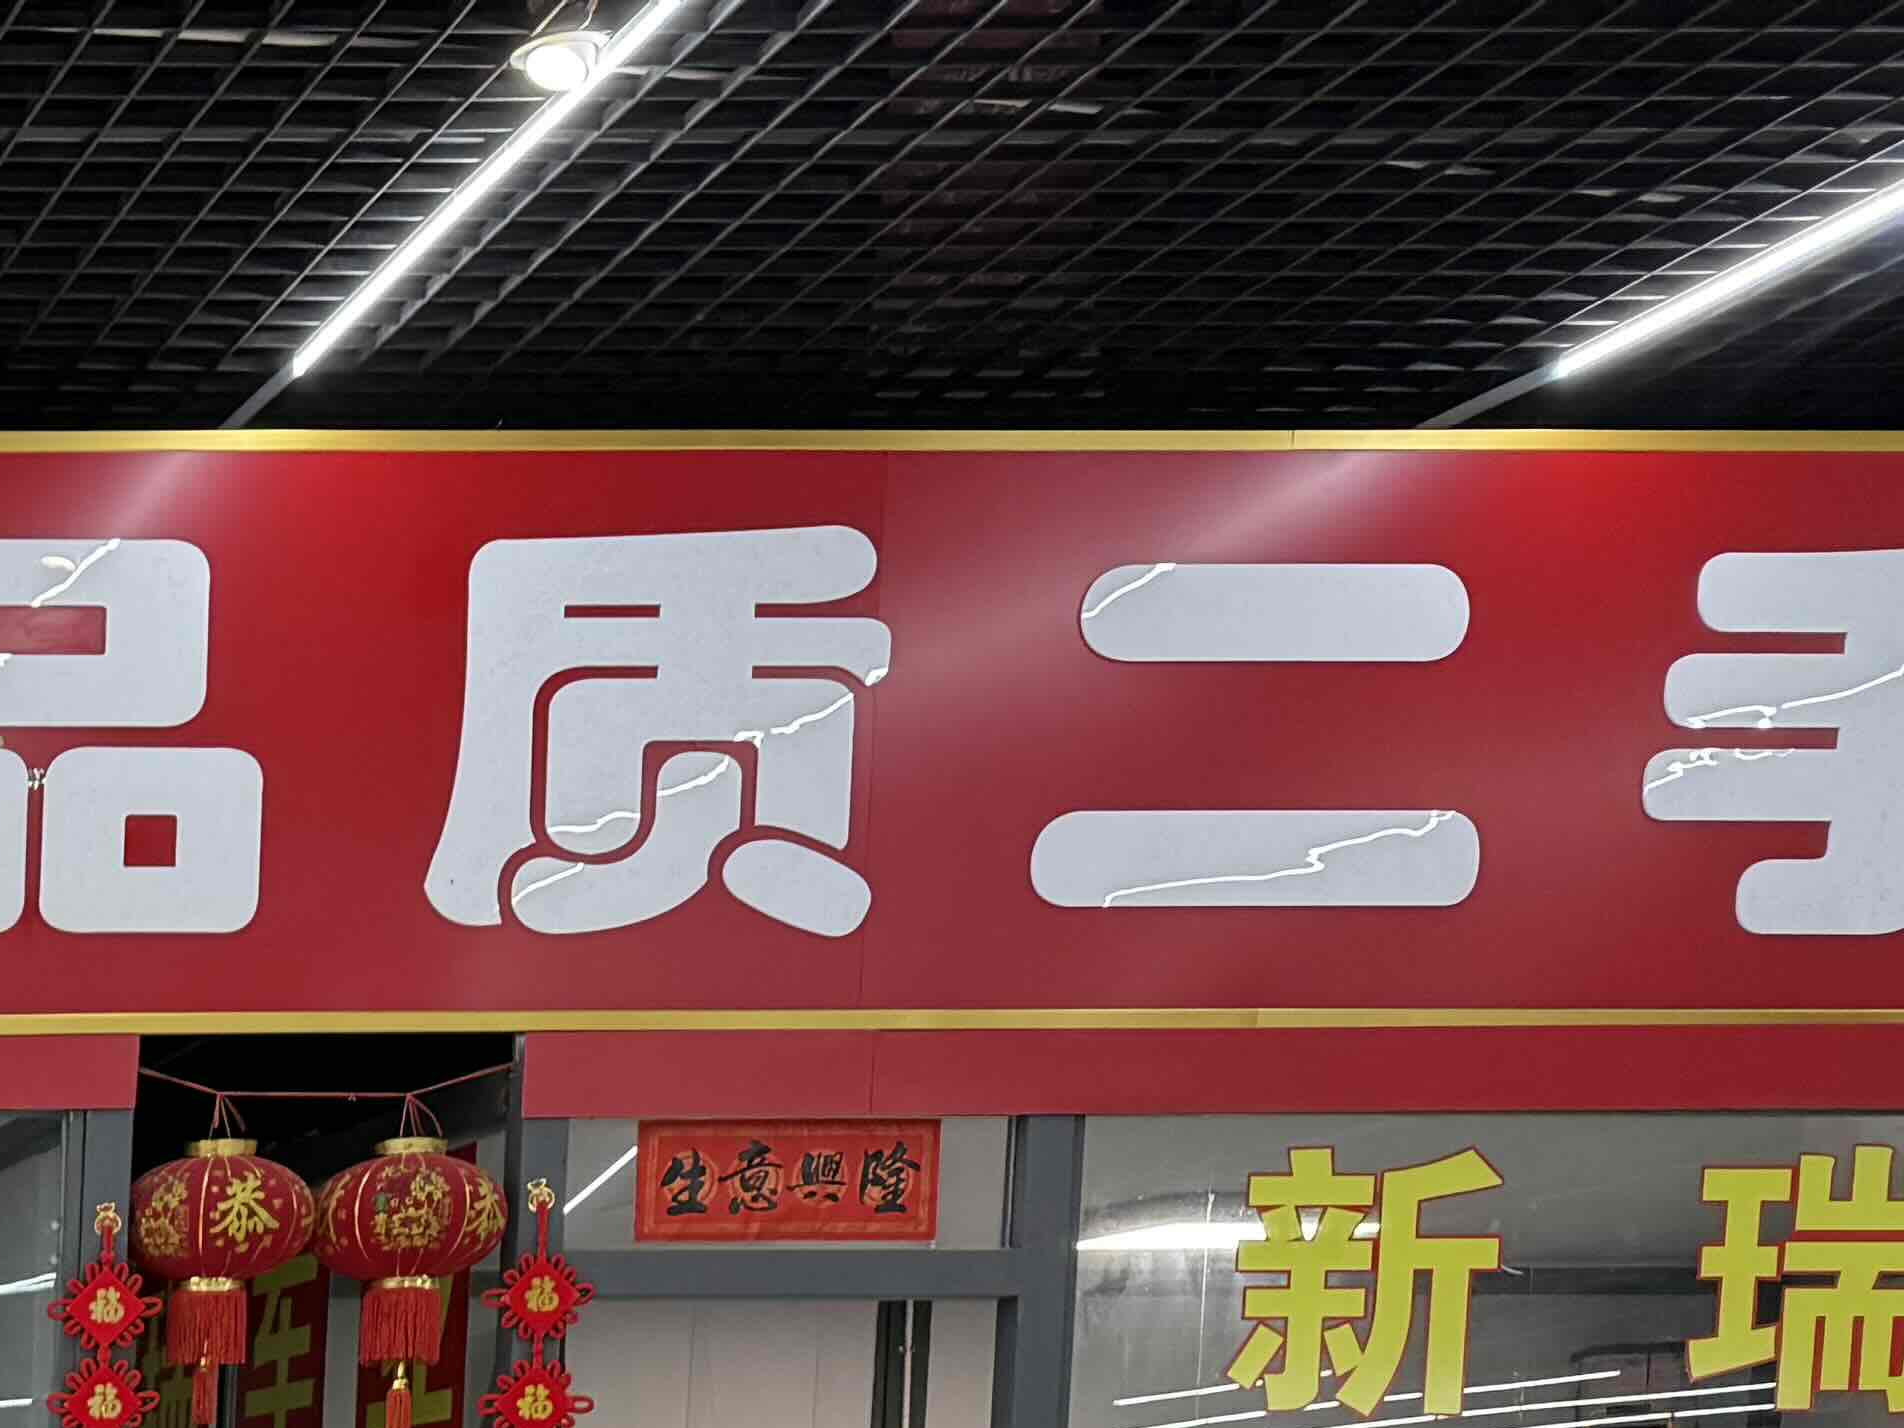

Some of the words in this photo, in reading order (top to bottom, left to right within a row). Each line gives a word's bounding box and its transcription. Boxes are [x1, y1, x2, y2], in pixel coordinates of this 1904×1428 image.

[88, 1287, 125, 1324] 福
[528, 1278, 560, 1314] 福
[87, 1382, 121, 1420] 福
[518, 1383, 553, 1421] 福
